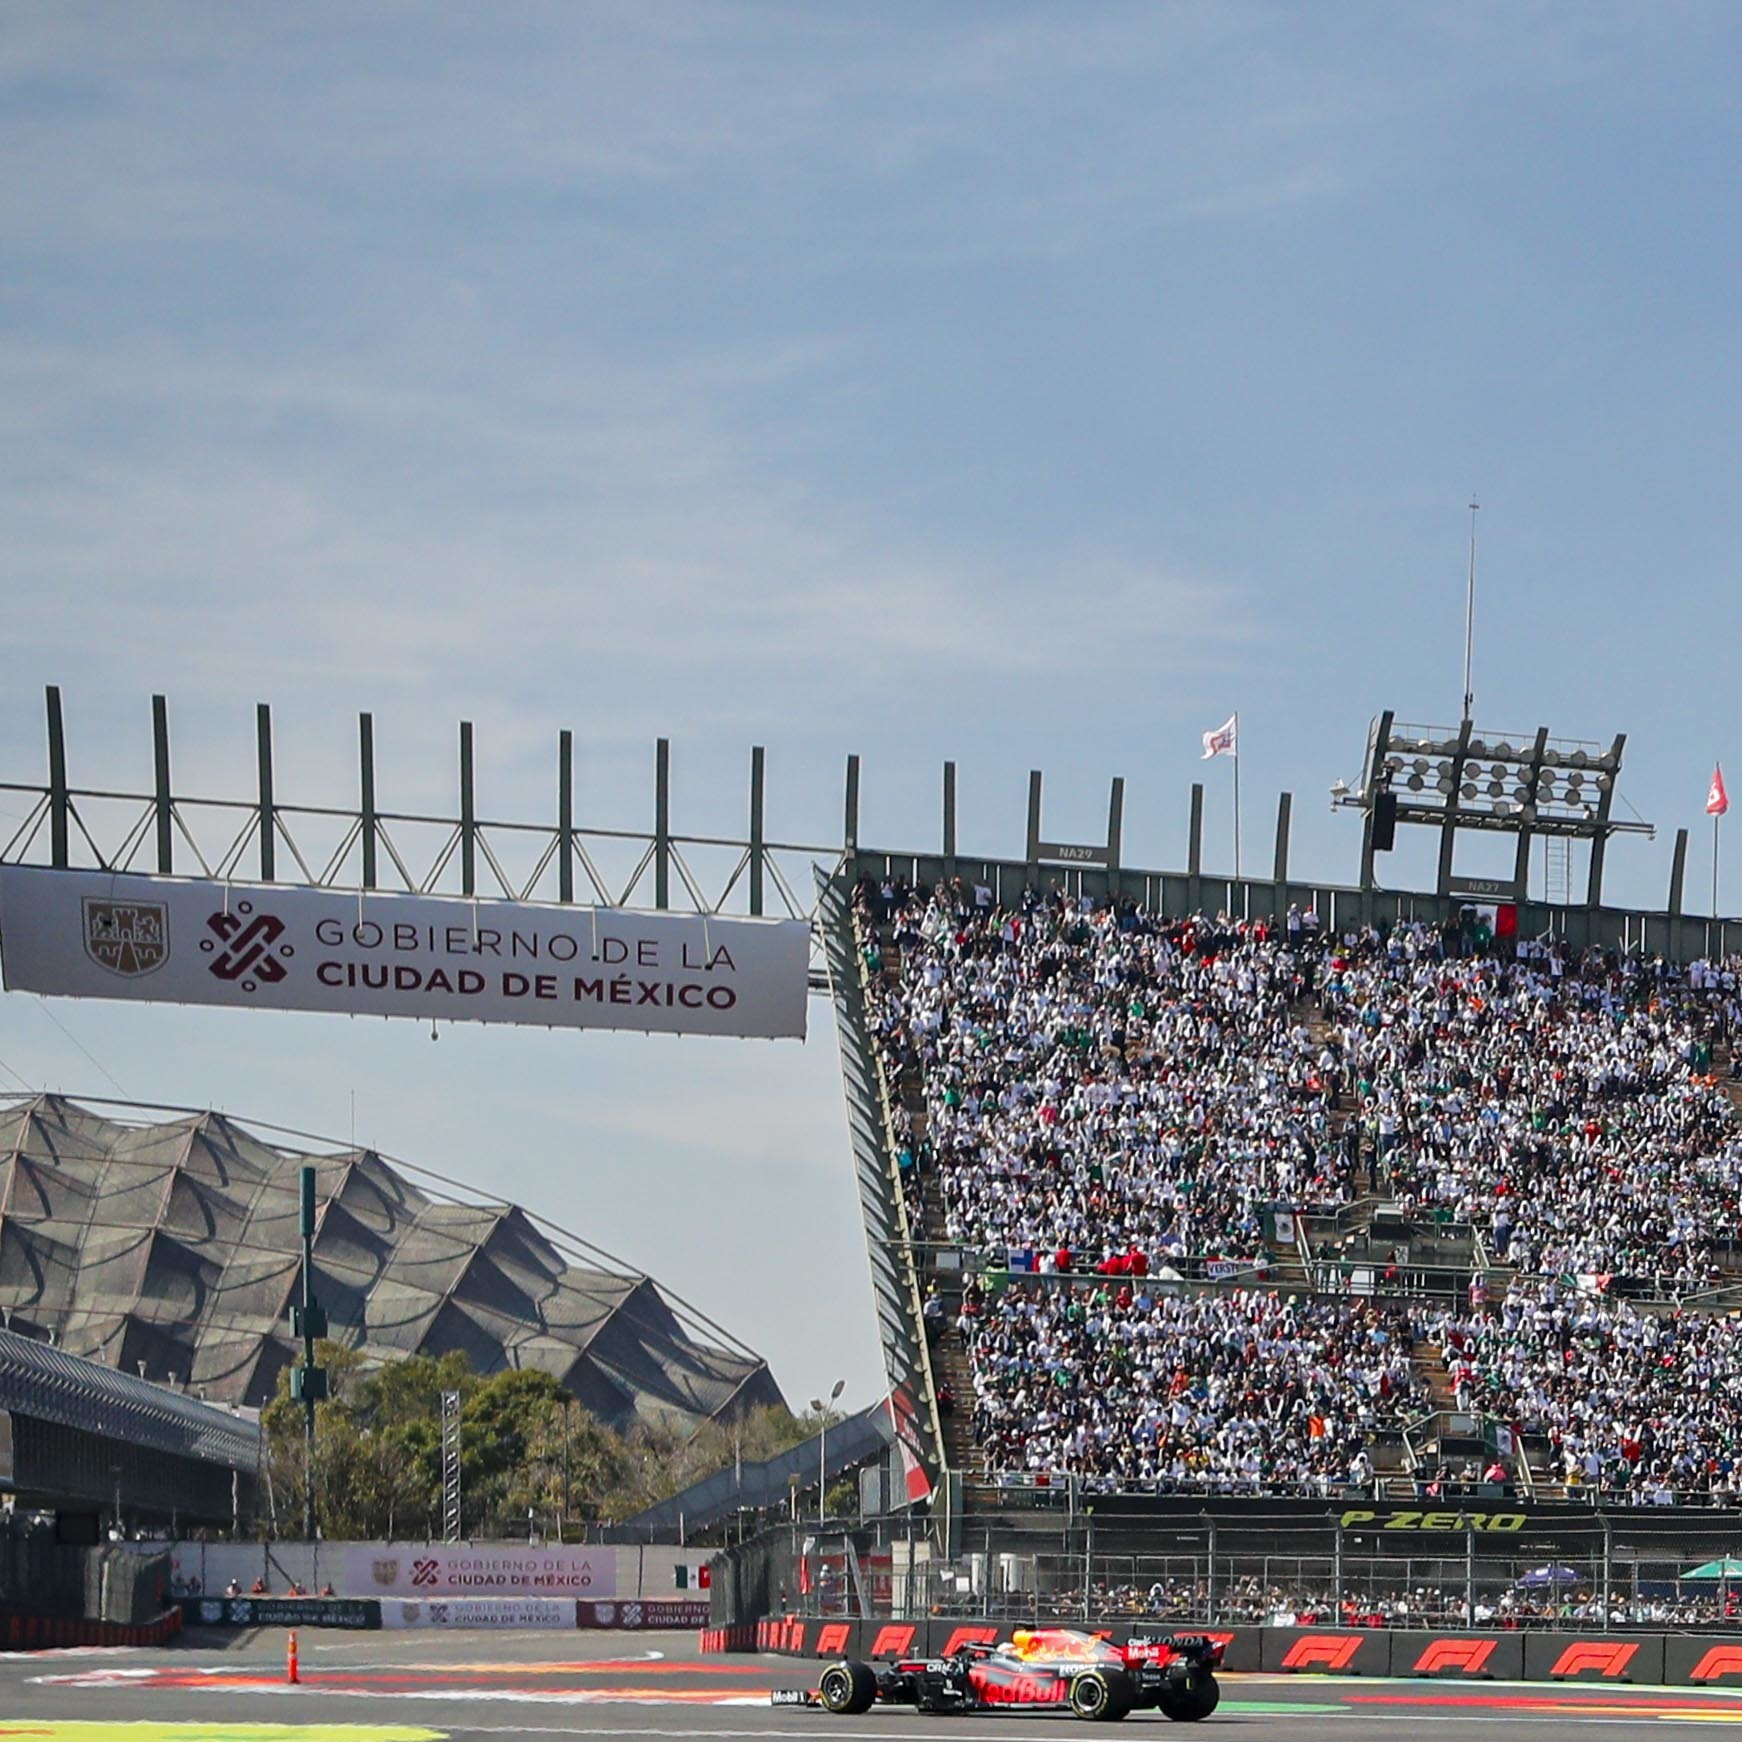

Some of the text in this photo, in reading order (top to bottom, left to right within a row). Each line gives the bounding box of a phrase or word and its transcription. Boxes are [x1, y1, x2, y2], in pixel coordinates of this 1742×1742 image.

[1059, 847, 1093, 859] NA29
[1469, 881, 1499, 892] NA27
[315, 918, 736, 971] GOBIERNO DE LA
[316, 961, 737, 1009] CIUDAD DE MÉXICO
[1341, 1510, 1528, 1532] P ZERO
[448, 1559, 592, 1572] GOBIERNO DE LA
[448, 1575, 506, 1588] CIUDAD
[511, 1575, 530, 1588] DE
[1128, 1647, 1160, 1659] Mobil
[1281, 1634, 1365, 1669] F1
[1413, 1639, 1498, 1673] F1
[1550, 1641, 1641, 1677] F1
